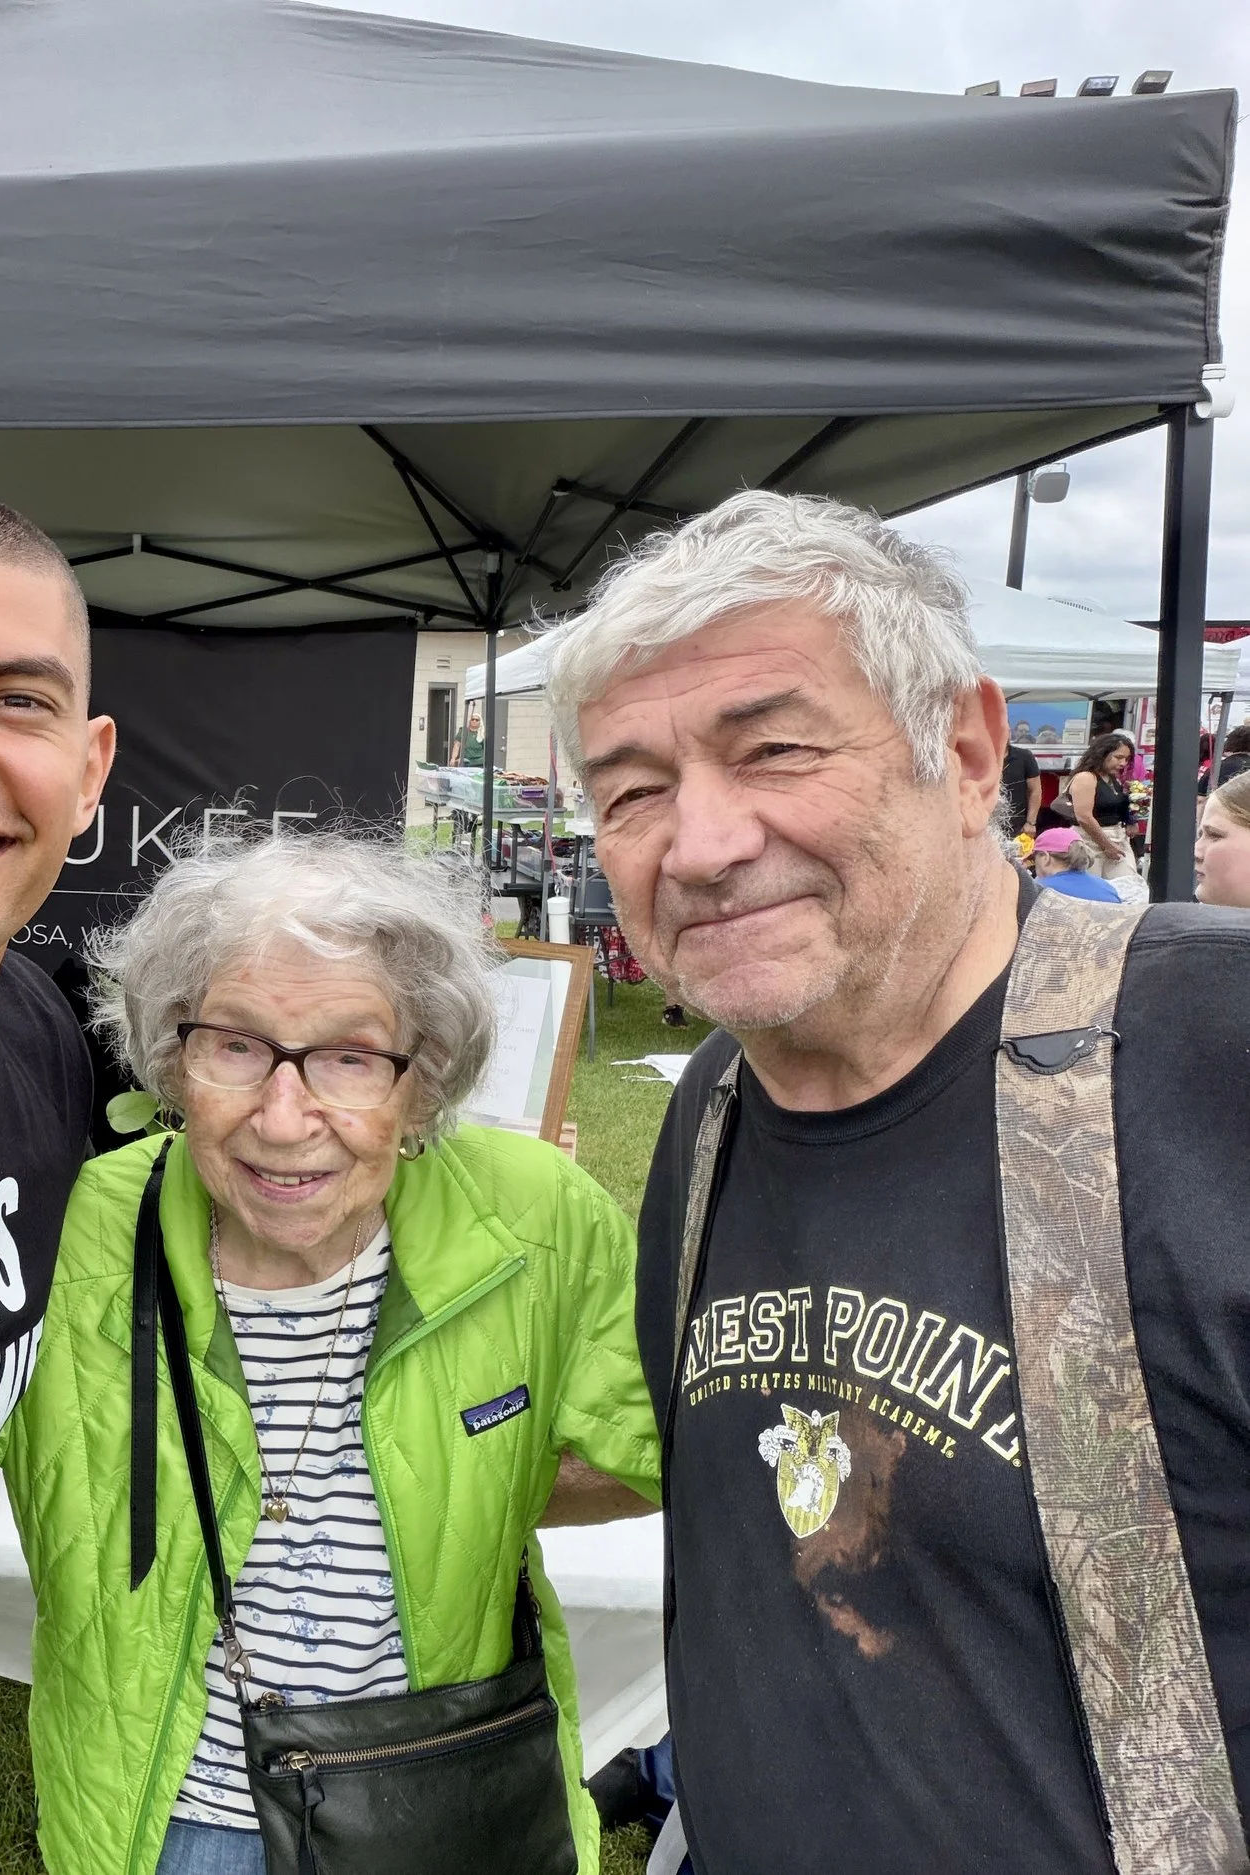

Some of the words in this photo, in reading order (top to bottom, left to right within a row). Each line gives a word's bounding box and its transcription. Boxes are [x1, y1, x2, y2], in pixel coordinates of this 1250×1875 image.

[10, 923, 74, 950] OSA,
[689, 1374, 732, 1407] UNITED
[740, 1372, 801, 1390] STATES
[807, 1374, 863, 1404] MILITARY
[472, 1399, 525, 1431] patagonia
